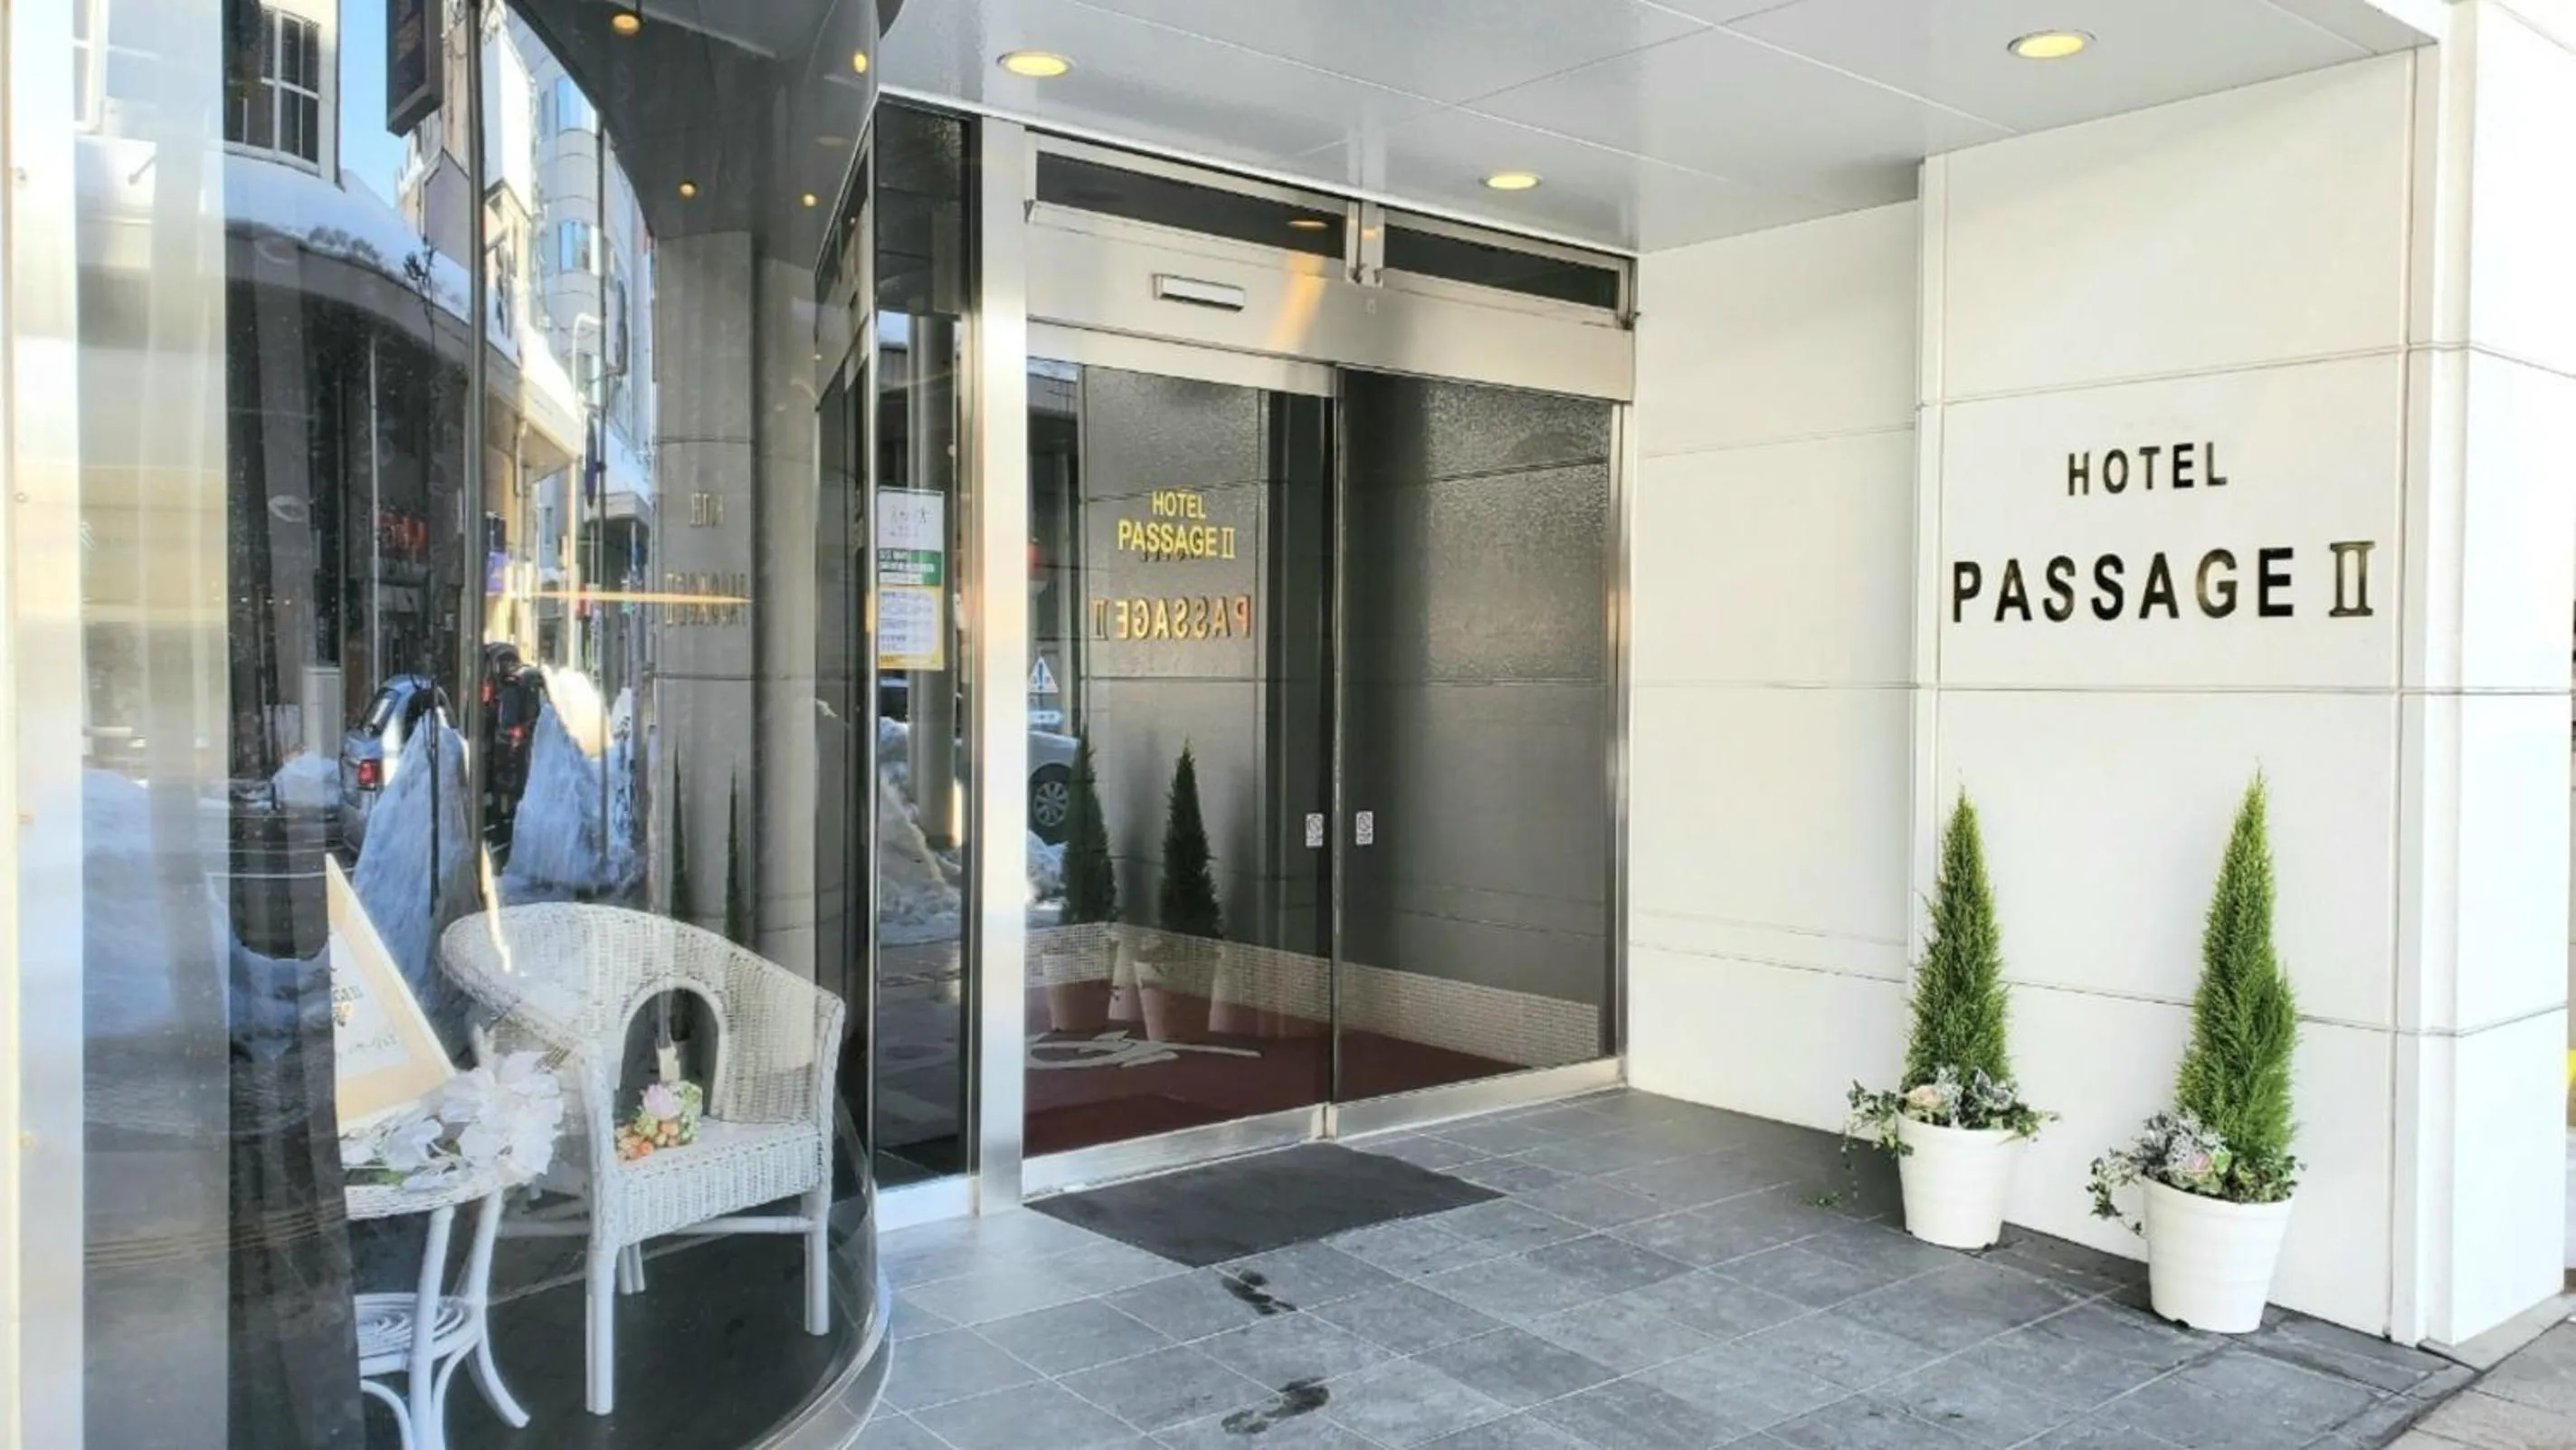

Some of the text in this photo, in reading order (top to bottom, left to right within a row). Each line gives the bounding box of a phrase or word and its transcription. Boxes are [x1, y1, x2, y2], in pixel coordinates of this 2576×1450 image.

[2068, 442, 2227, 496] HOTEL
[1152, 491, 1207, 520] HOTEL
[1117, 519, 1218, 557] PASSAGE
[1952, 547, 2295, 623] PASSAGE
